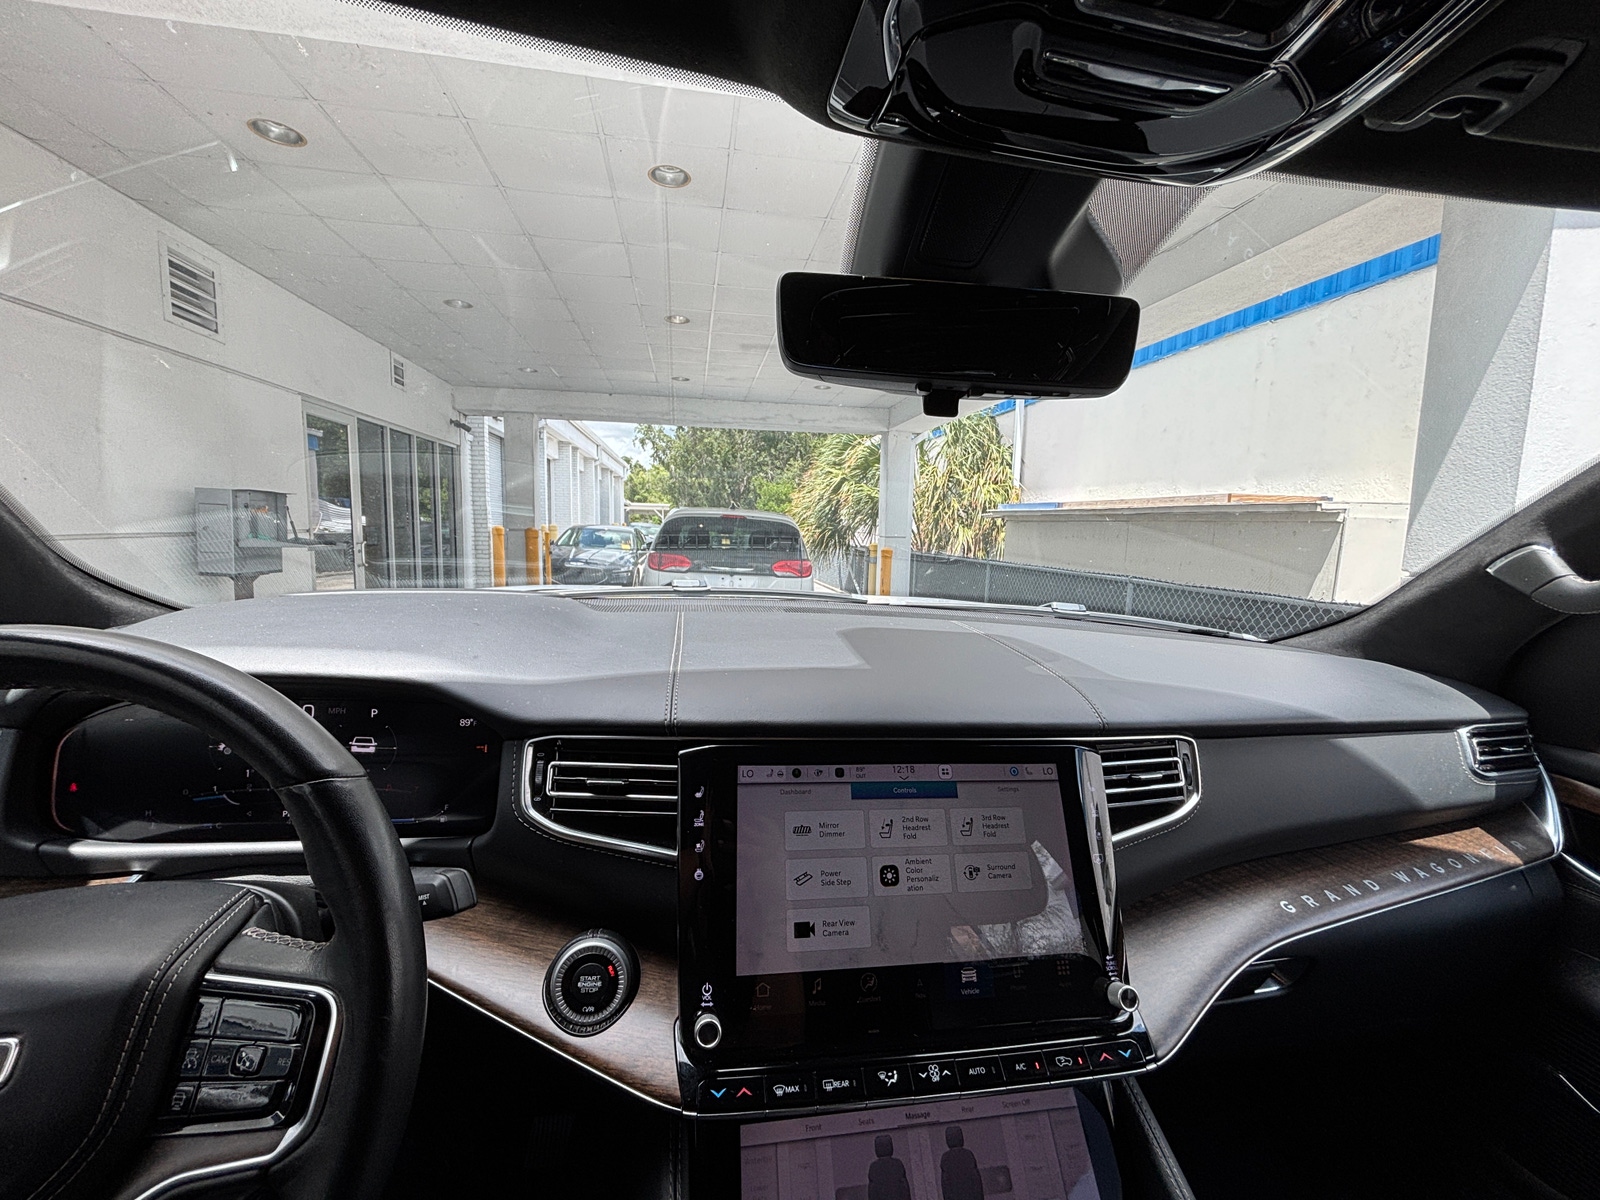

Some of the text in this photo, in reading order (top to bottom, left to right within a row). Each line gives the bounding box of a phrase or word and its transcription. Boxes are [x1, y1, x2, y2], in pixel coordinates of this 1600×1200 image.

[327, 707, 347, 715] MPH
[370, 708, 379, 718] P
[741, 769, 754, 779] LO
[892, 765, 916, 774] 12:18
[1042, 767, 1054, 776] LO
[779, 788, 812, 796] Dashboard
[893, 787, 917, 795] Controls
[997, 785, 1020, 794] Settings
[902, 815, 930, 824] 2nd Row
[981, 814, 1007, 822] 3rd Row
[818, 821, 840, 830] Mirror
[902, 823, 932, 832] Headrest
[981, 821, 1010, 831] Headrest
[818, 830, 846, 839] Dimmer
[902, 832, 918, 841] Fold
[982, 829, 998, 838] Fold
[904, 857, 933, 866] Ambient
[905, 866, 924, 875] Color
[986, 862, 1017, 871] Surround
[820, 869, 842, 878] Power
[987, 871, 1013, 880] Camera
[820, 877, 852, 888] Side Step
[906, 874, 940, 883] Personaliz
[906, 884, 925, 892] ation
[1279, 878, 1380, 914] GRAND
[821, 918, 856, 929] Rear View
[822, 928, 850, 937] Camera
[960, 987, 981, 996] Vehicle
[968, 1066, 986, 1075] AUTO
[1015, 1062, 1027, 1071] A/C
[833, 1079, 850, 1088] REAR
[785, 1085, 800, 1093] MAX
[905, 1110, 931, 1121] Massage
[858, 1117, 875, 1127] Seats
[805, 1123, 822, 1132] Front
